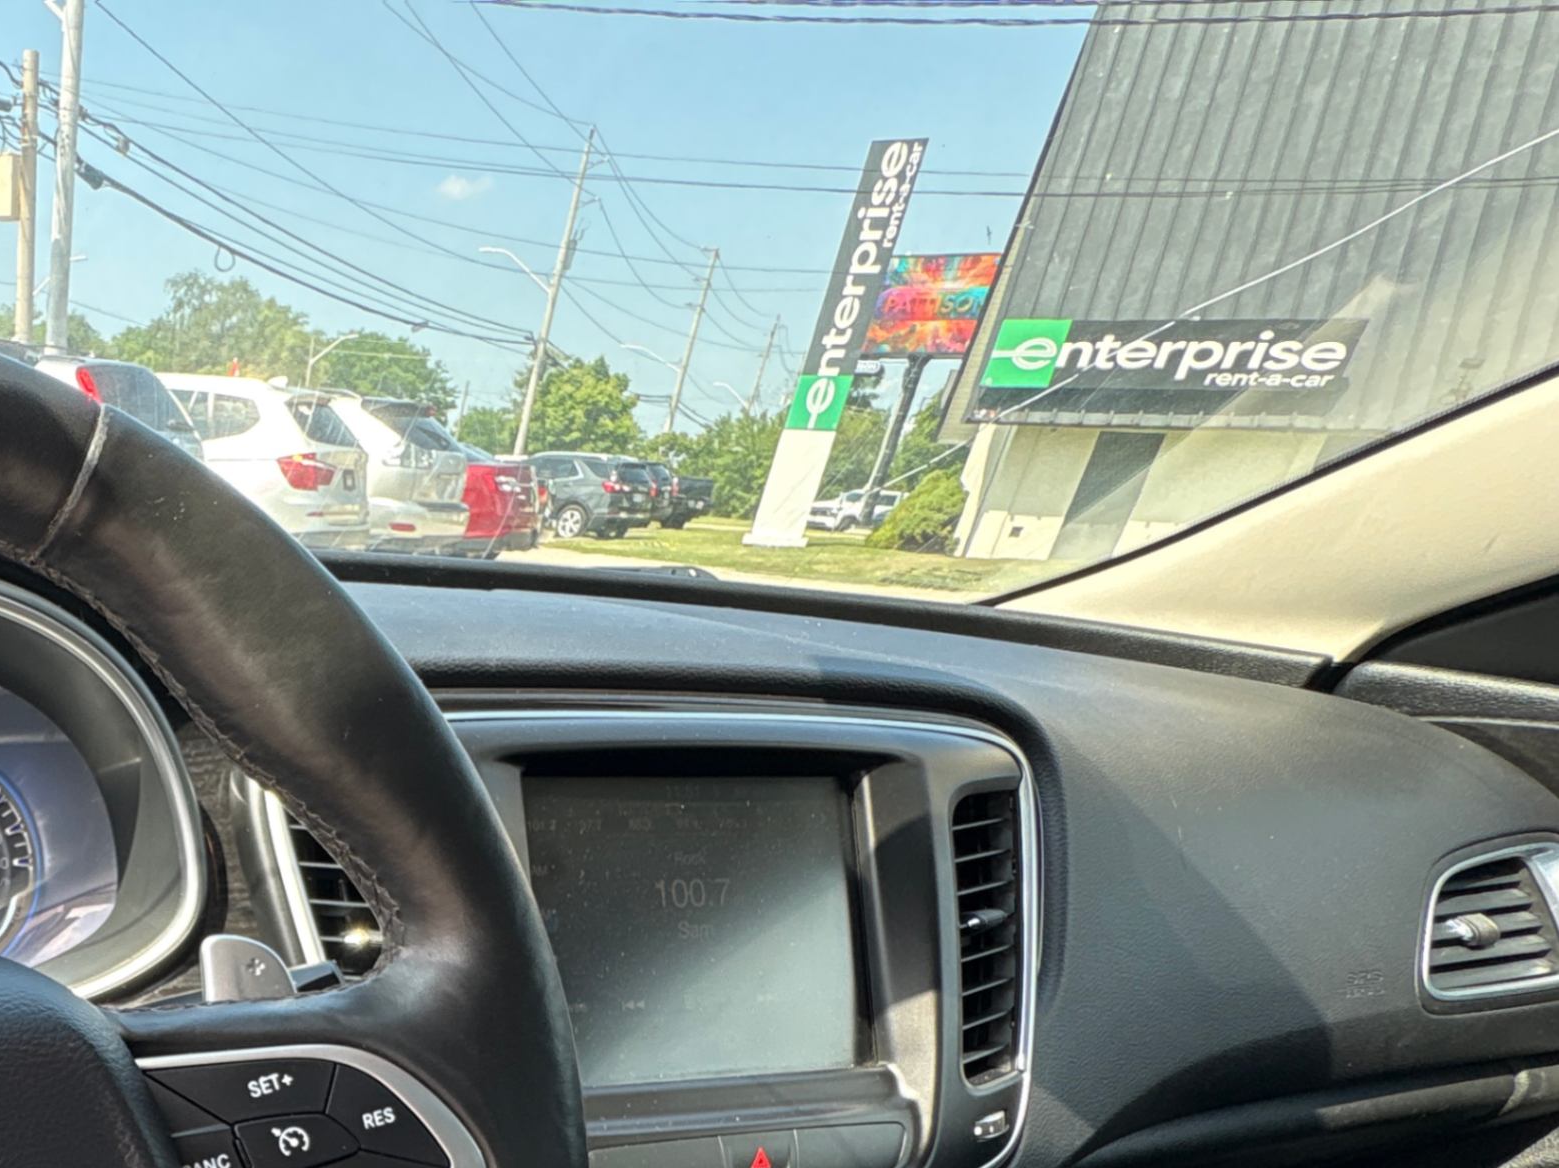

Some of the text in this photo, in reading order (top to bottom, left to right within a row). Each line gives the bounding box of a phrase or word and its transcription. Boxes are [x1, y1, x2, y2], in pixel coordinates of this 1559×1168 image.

[882, 142, 923, 248] rent-a-car
[806, 141, 908, 422] enterprise
[1010, 329, 1347, 381] enterprise
[1203, 370, 1336, 388] rent-a-car
[654, 878, 731, 909] 100.7
[362, 1107, 395, 1130] RES
